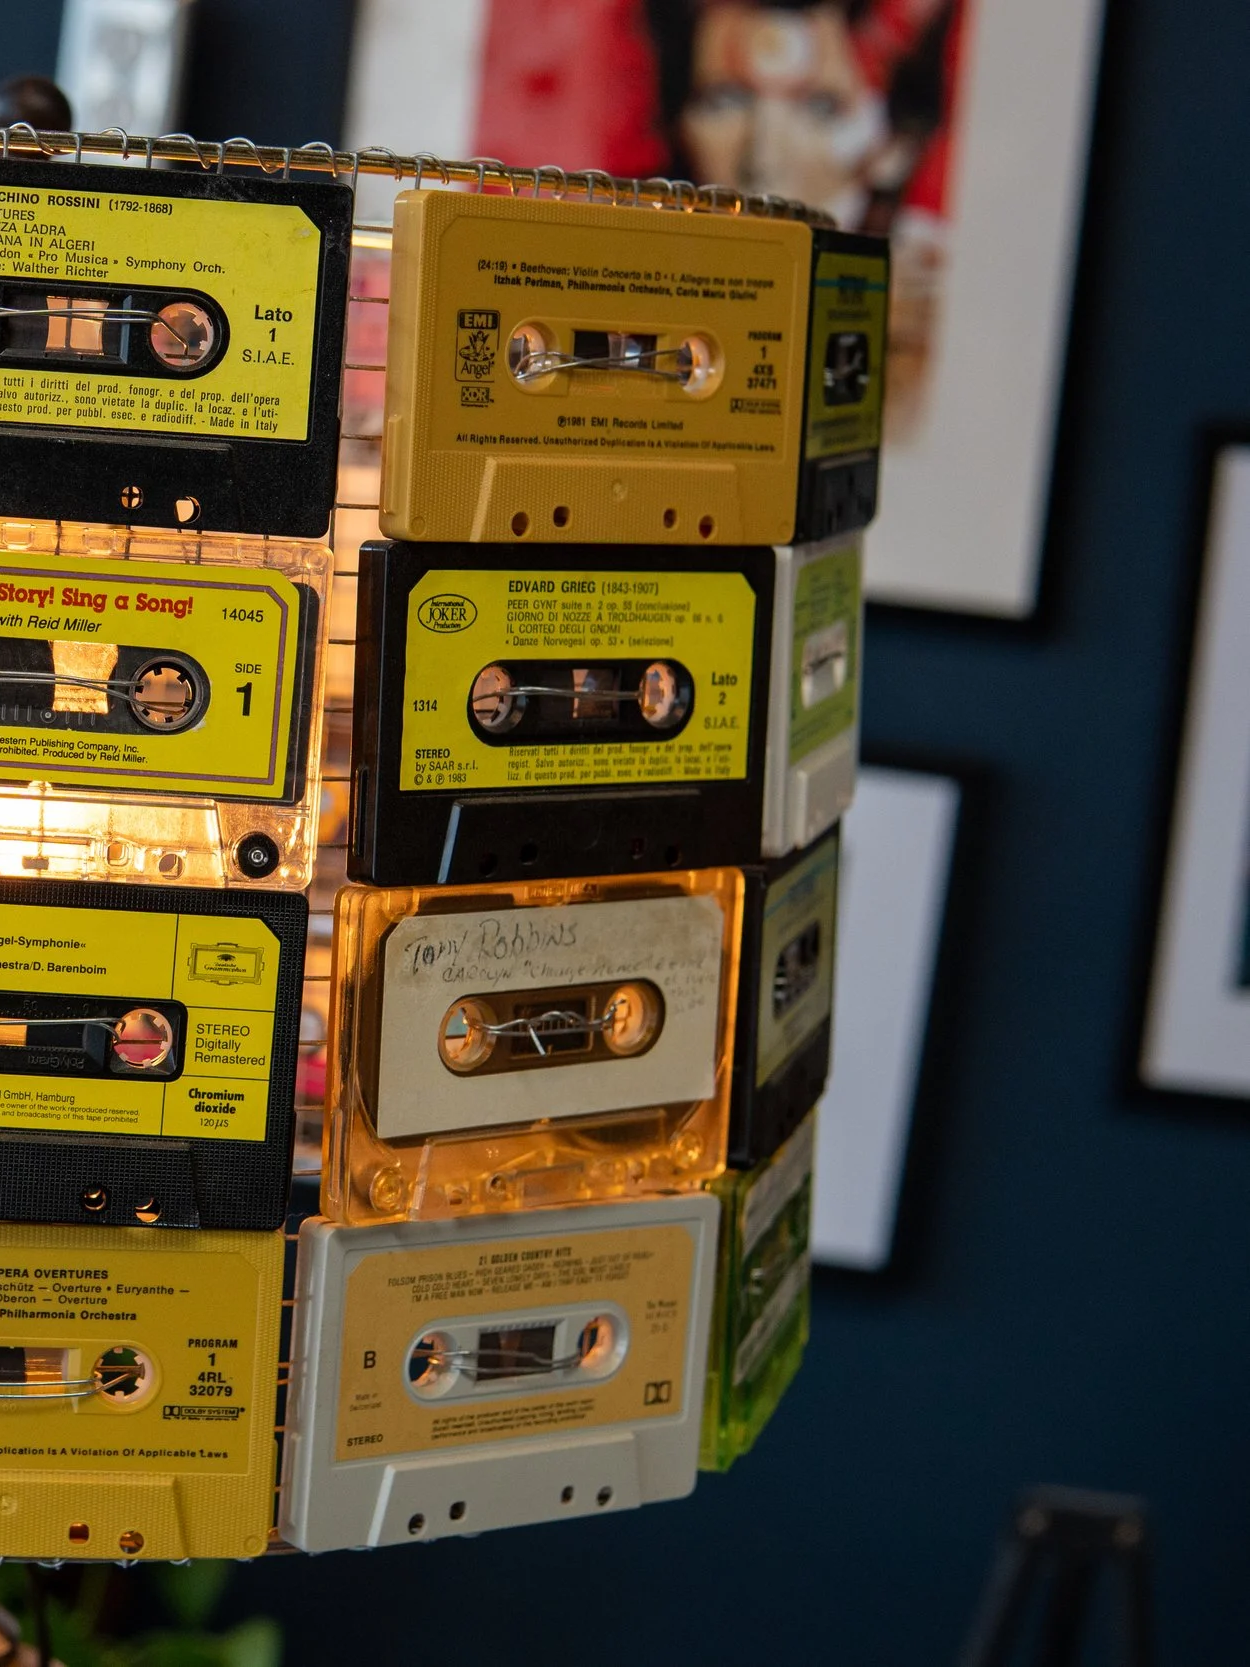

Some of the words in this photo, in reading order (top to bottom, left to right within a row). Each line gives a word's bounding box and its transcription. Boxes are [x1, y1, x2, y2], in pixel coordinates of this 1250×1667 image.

[47, 194, 100, 209] ROSSINI
[108, 198, 173, 216] (1792-1868)
[23, 223, 67, 237] LADRA
[29, 236, 44, 248] IN
[48, 238, 95, 252] ALGERI
[12, 260, 60, 275] Walther
[65, 264, 109, 279] Richter
[255, 304, 292, 322] Lato
[464, 313, 493, 327] EMI
[268, 328, 277, 342] 1
[242, 349, 295, 366] S.I.A.E.
[461, 363, 491, 378] Angel
[508, 579, 556, 594] EDVARD
[560, 580, 596, 594] GRIEG
[61, 587, 108, 614] Sing
[114, 594, 130, 611] a
[135, 592, 194, 619] Song!
[222, 608, 263, 623] 14045
[426, 608, 467, 623] JOKER
[26, 615, 61, 630] Reid
[63, 617, 103, 633] Miller
[234, 663, 262, 675] SIDE
[712, 672, 737, 686] Lato
[236, 682, 252, 716] 1
[718, 692, 726, 705] 2
[413, 700, 437, 712] 1314
[704, 717, 739, 730] S.I.A.E.
[415, 749, 450, 759] STEREO
[46, 962, 107, 975] Barenboim
[196, 1023, 250, 1037] STEREO
[195, 1038, 241, 1051] Digitally
[194, 1051, 265, 1066] Remastered
[188, 1088, 244, 1101] Chromium
[194, 1101, 236, 1114] dioxide
[33, 1268, 109, 1280] OVERTURES
[0, 1308, 76, 1320] Philharmonia
[79, 1309, 137, 1321] Orchestra
[188, 1339, 238, 1348] PROGRAM
[208, 1353, 215, 1366] 1
[363, 1351, 377, 1368] B
[198, 1372, 226, 1384] 4RL
[189, 1385, 233, 1396] 32079
[347, 1433, 384, 1447] STEREO
